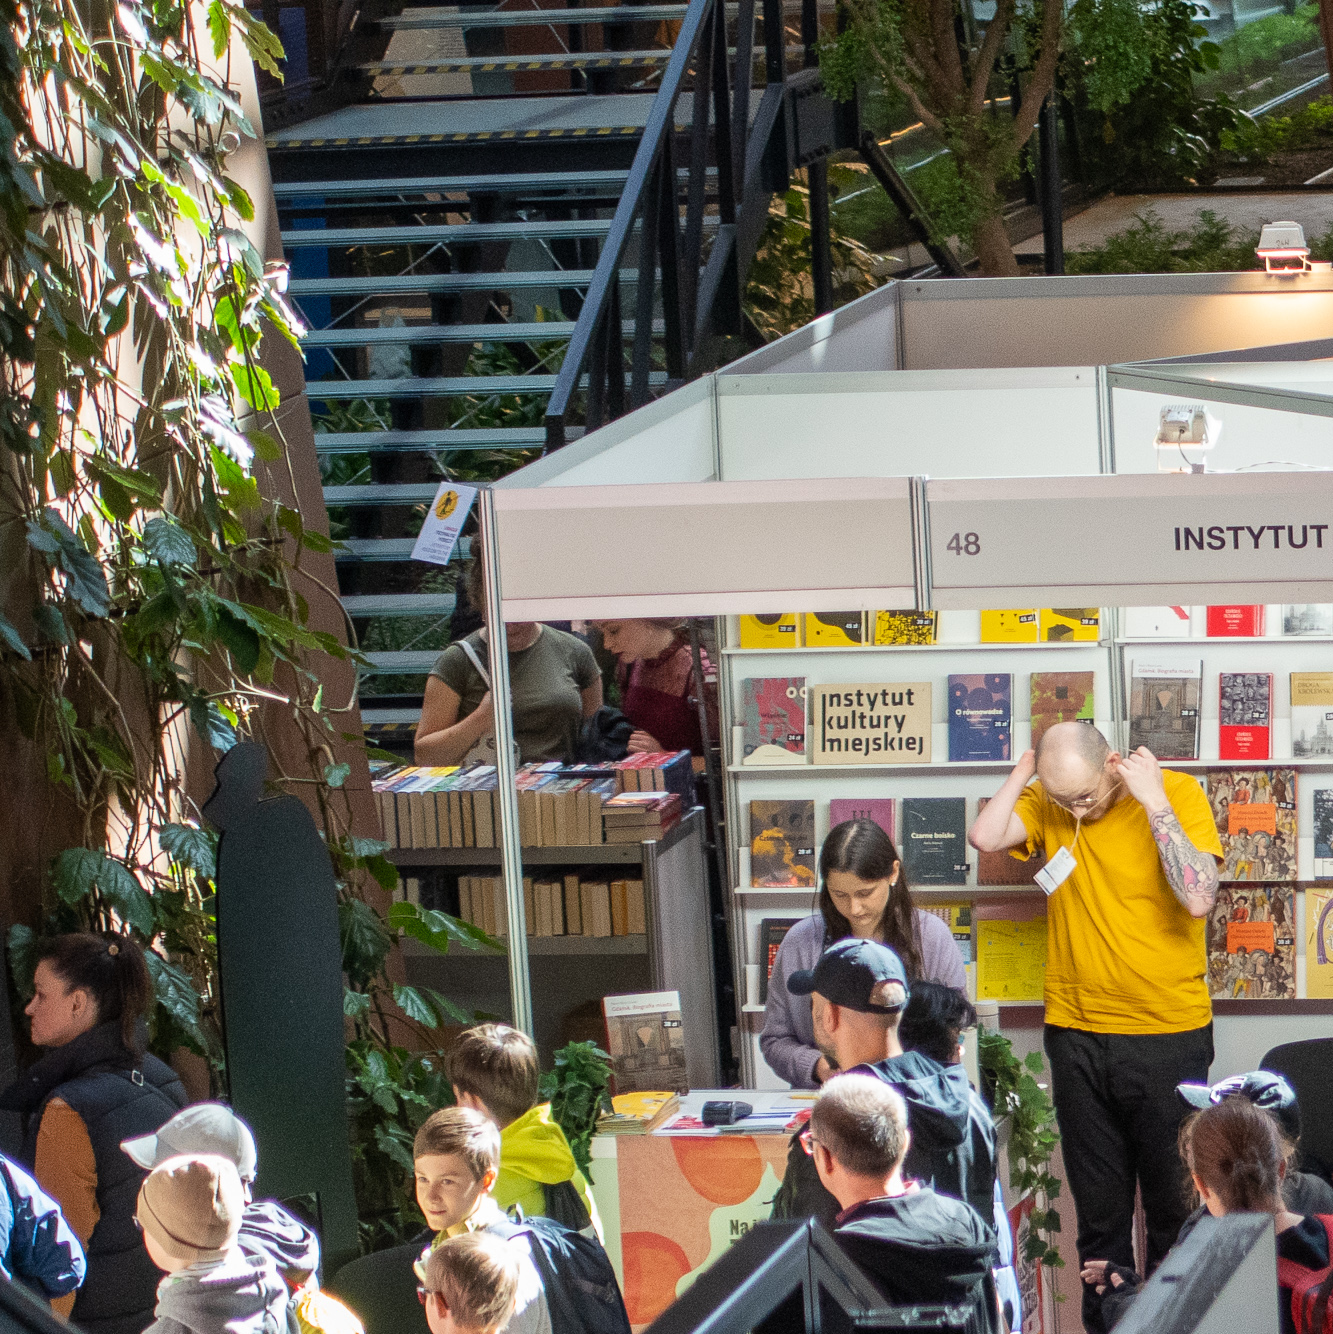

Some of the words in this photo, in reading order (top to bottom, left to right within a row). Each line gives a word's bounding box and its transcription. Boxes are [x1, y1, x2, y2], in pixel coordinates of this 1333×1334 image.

[947, 532, 983, 557] 48
[1175, 525, 1330, 552] INSTYTUT
[911, 831, 936, 839] Czarne
